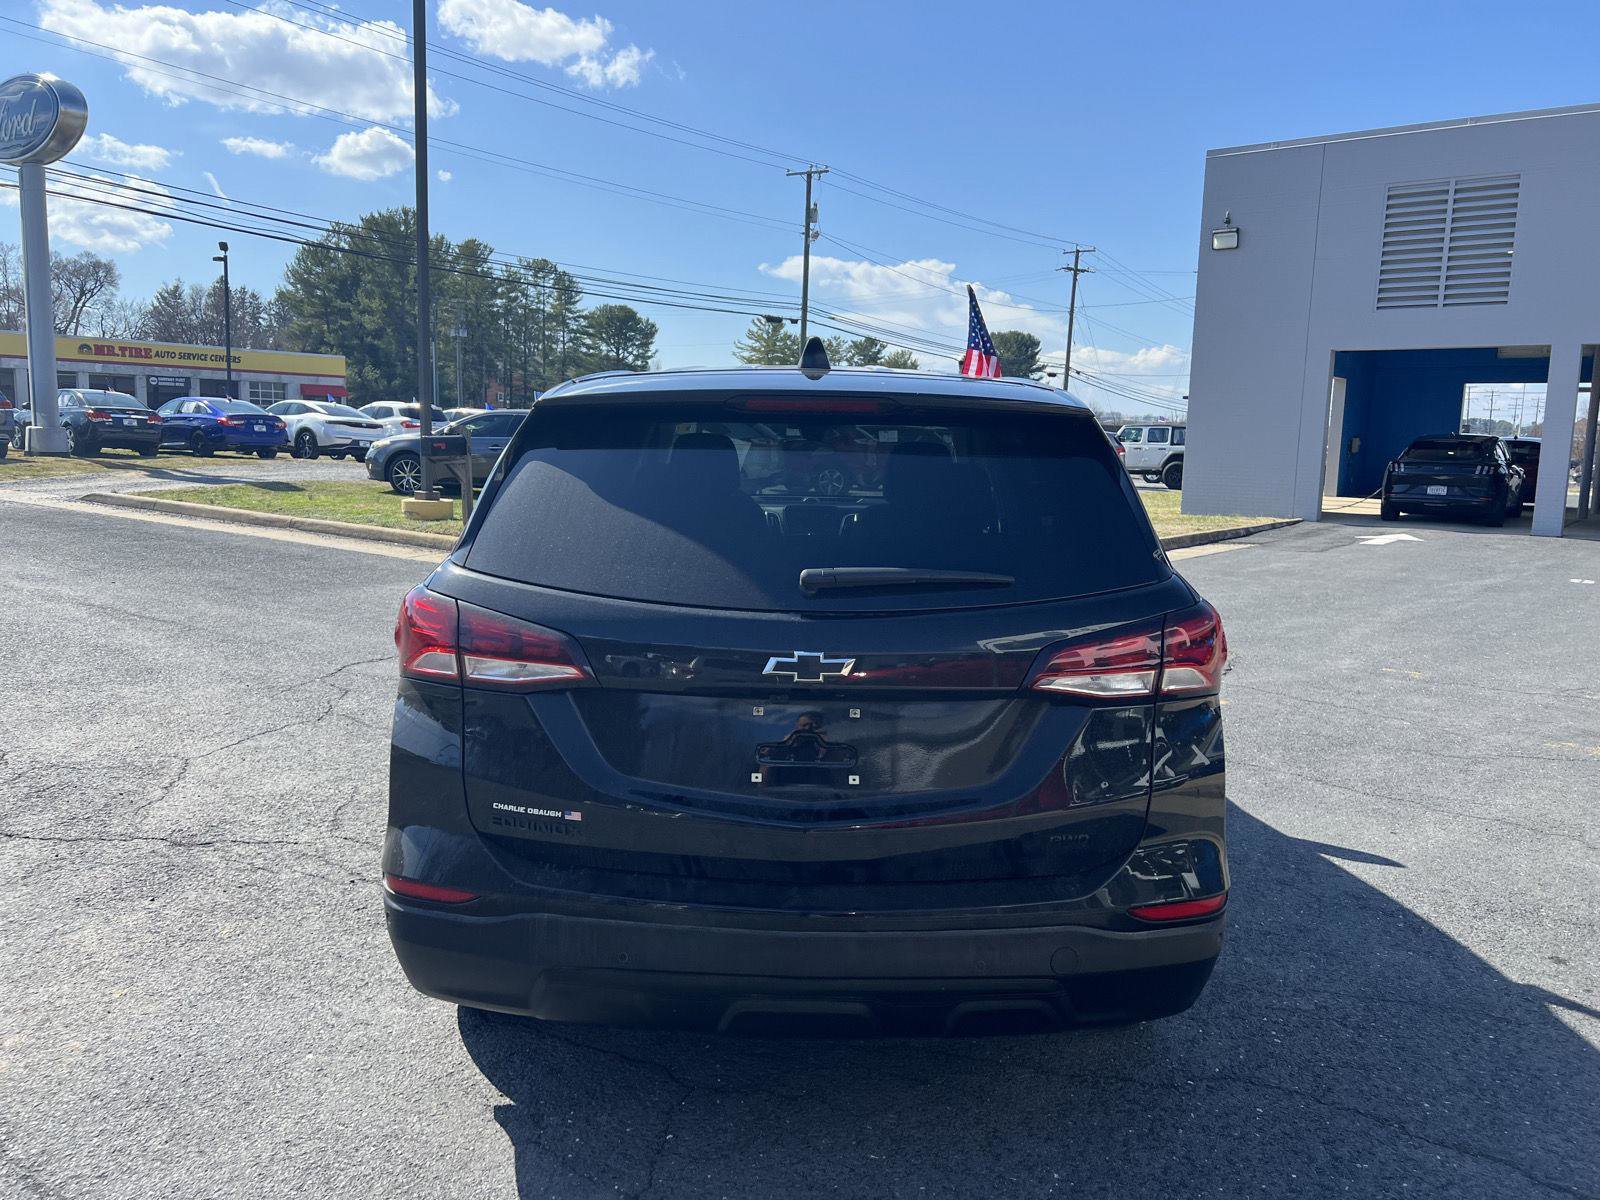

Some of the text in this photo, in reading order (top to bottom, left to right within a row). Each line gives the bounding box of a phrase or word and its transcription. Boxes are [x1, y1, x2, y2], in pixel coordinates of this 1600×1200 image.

[119, 346, 152, 359] TIRE
[154, 350, 177, 360] AUTO
[178, 351, 208, 362] SERVICE
[492, 802, 562, 818] CHARLIE OBAUGH
